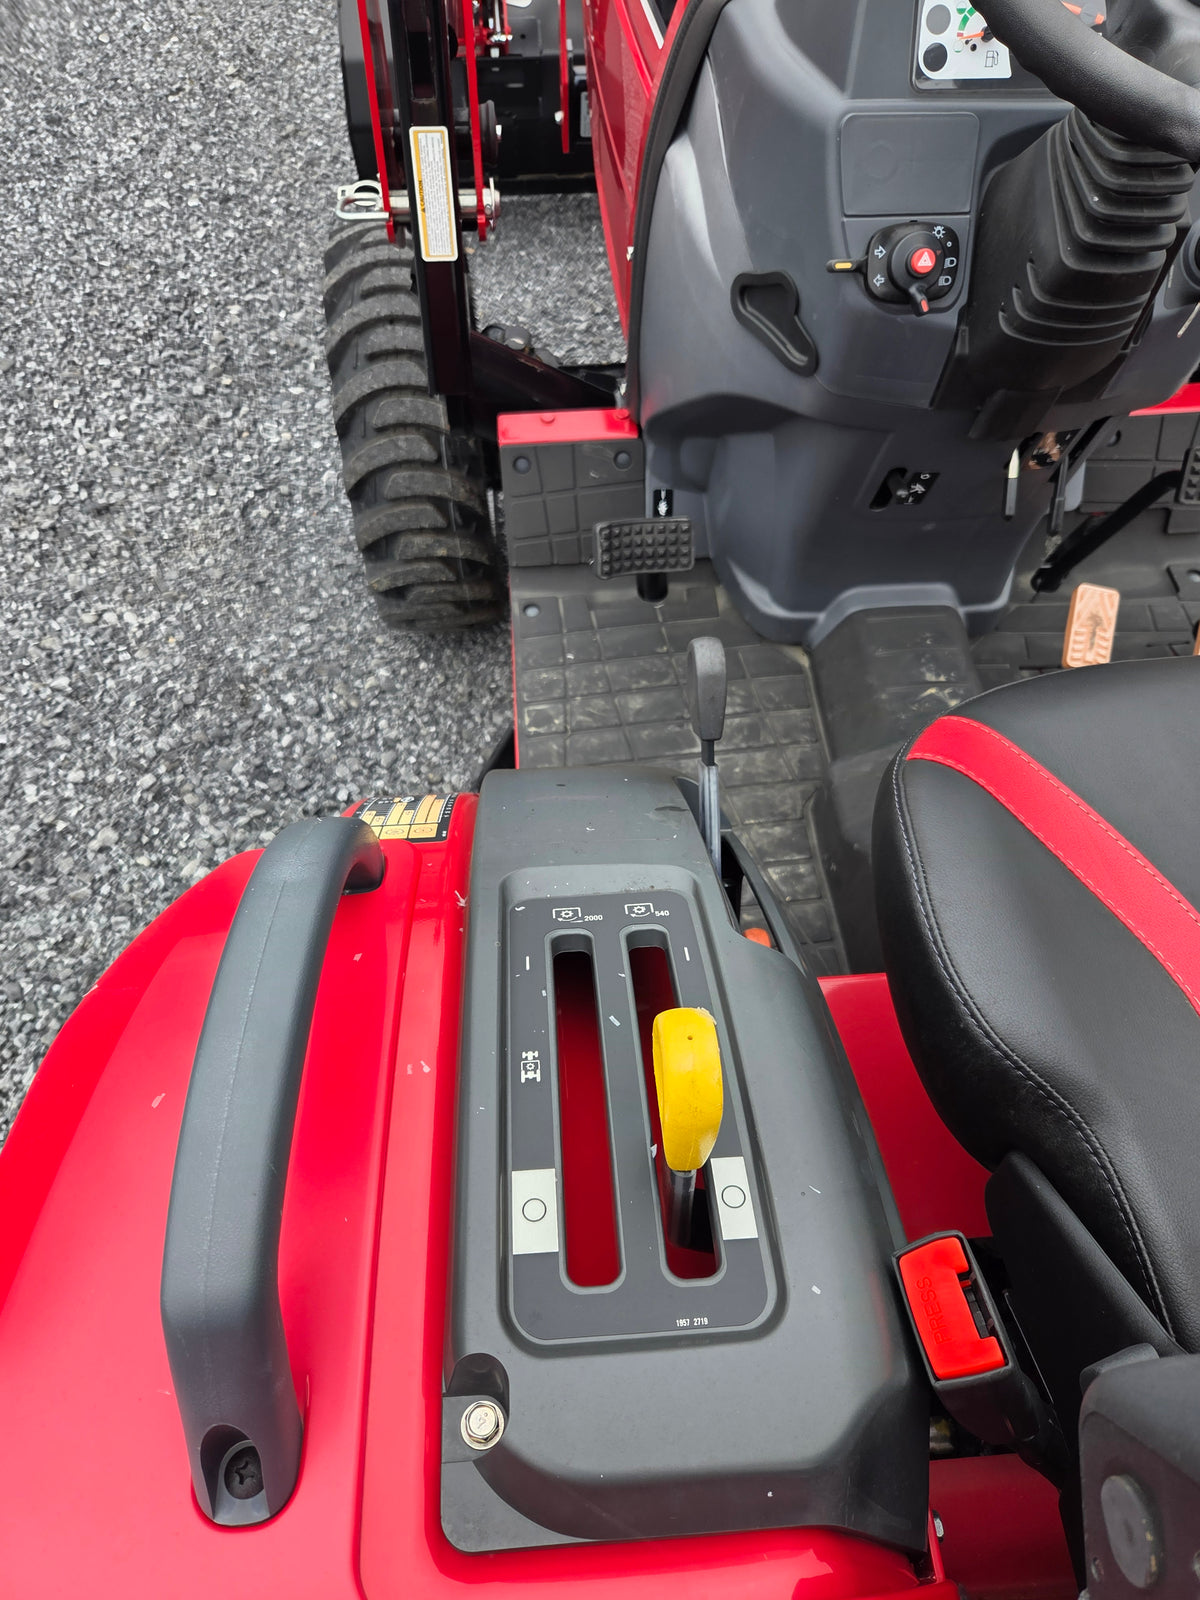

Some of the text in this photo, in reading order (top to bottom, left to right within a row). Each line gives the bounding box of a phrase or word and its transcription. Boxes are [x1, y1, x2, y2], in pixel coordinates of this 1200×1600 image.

[418, 180, 426, 207] CAUTION
[584, 914, 604, 922] 2000
[655, 909, 670, 917] 540
[916, 1276, 953, 1345] PRESS
[693, 1316, 709, 1326] 2719
